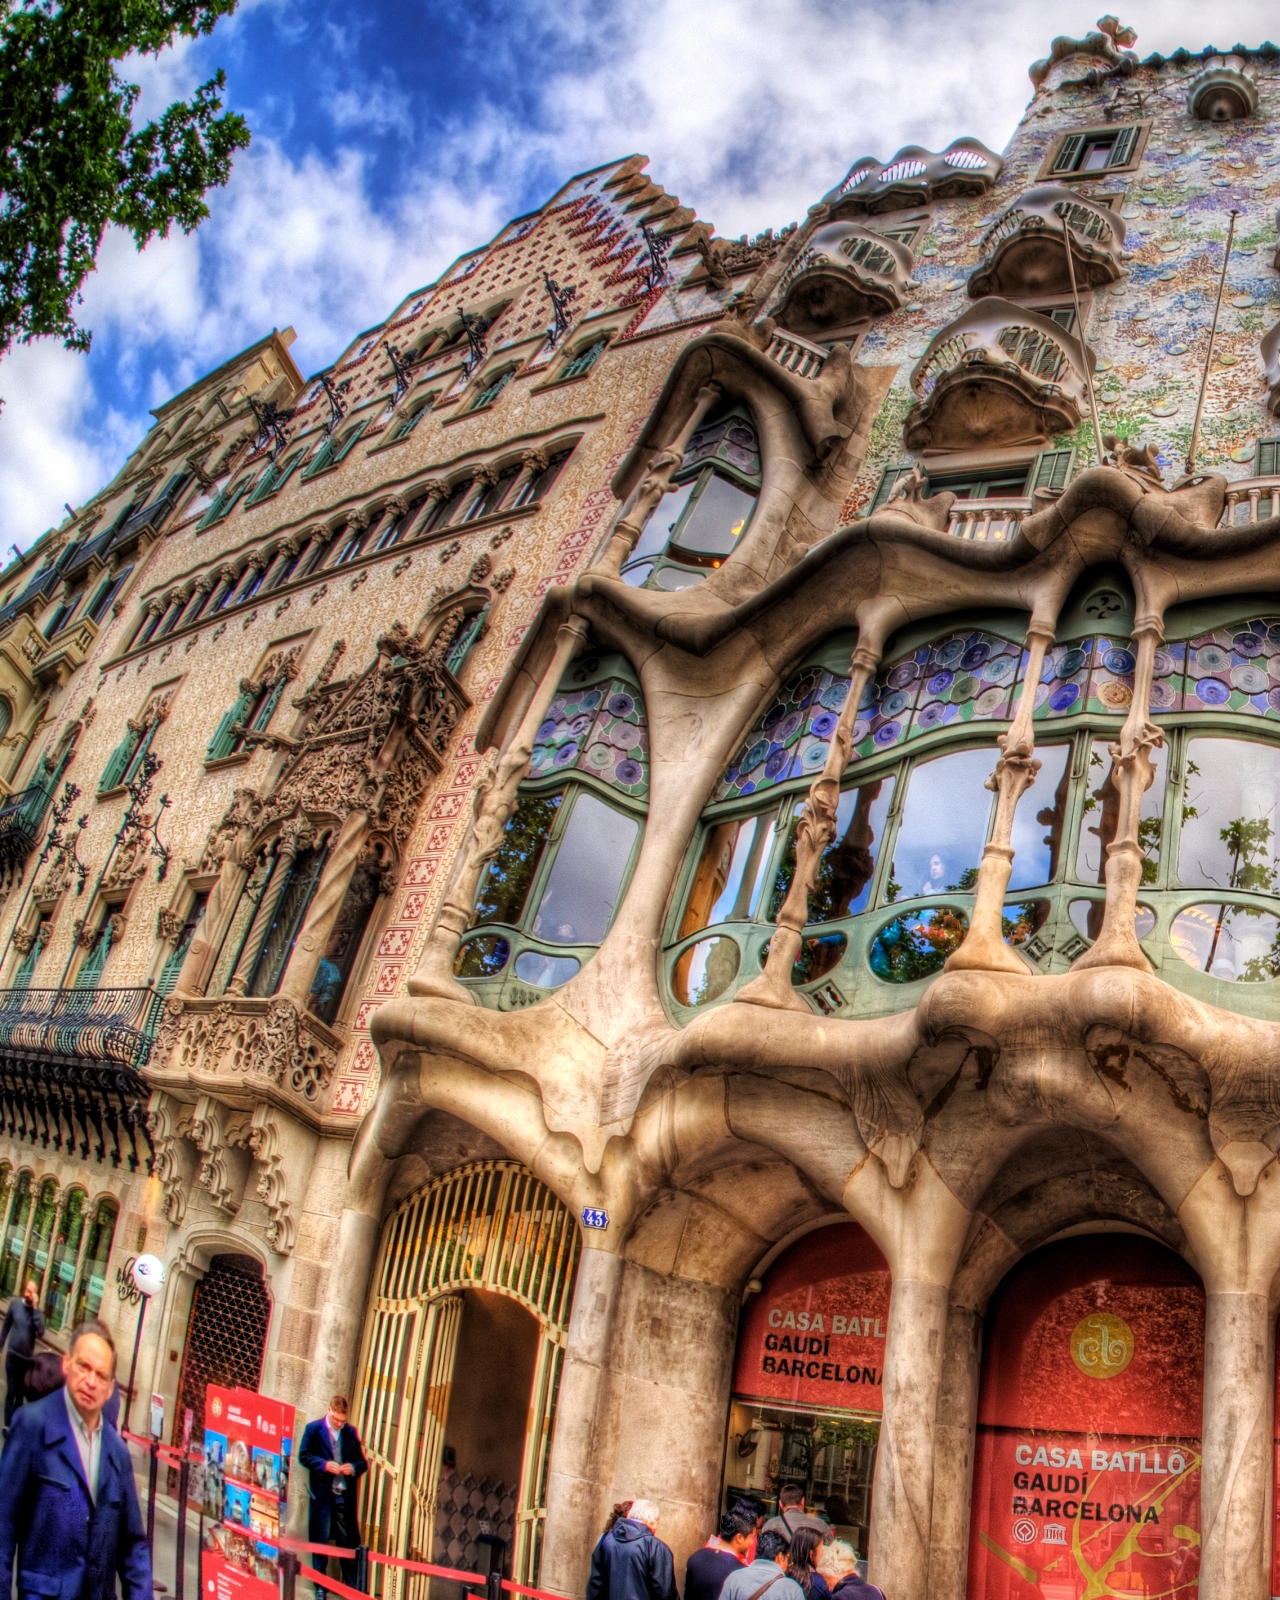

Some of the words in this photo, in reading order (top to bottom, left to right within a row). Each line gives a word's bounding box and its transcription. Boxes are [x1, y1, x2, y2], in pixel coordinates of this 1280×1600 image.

[586, 1210, 603, 1226] 43
[768, 1309, 825, 1333] CASA
[832, 1315, 886, 1338] BATL
[765, 1334, 831, 1356] GAUDÍ
[1015, 1444, 1083, 1470] CASA
[1091, 1449, 1186, 1475] BATLLÓ
[1014, 1471, 1089, 1495] GAUDÍ
[1013, 1496, 1160, 1525] BARCELONA
